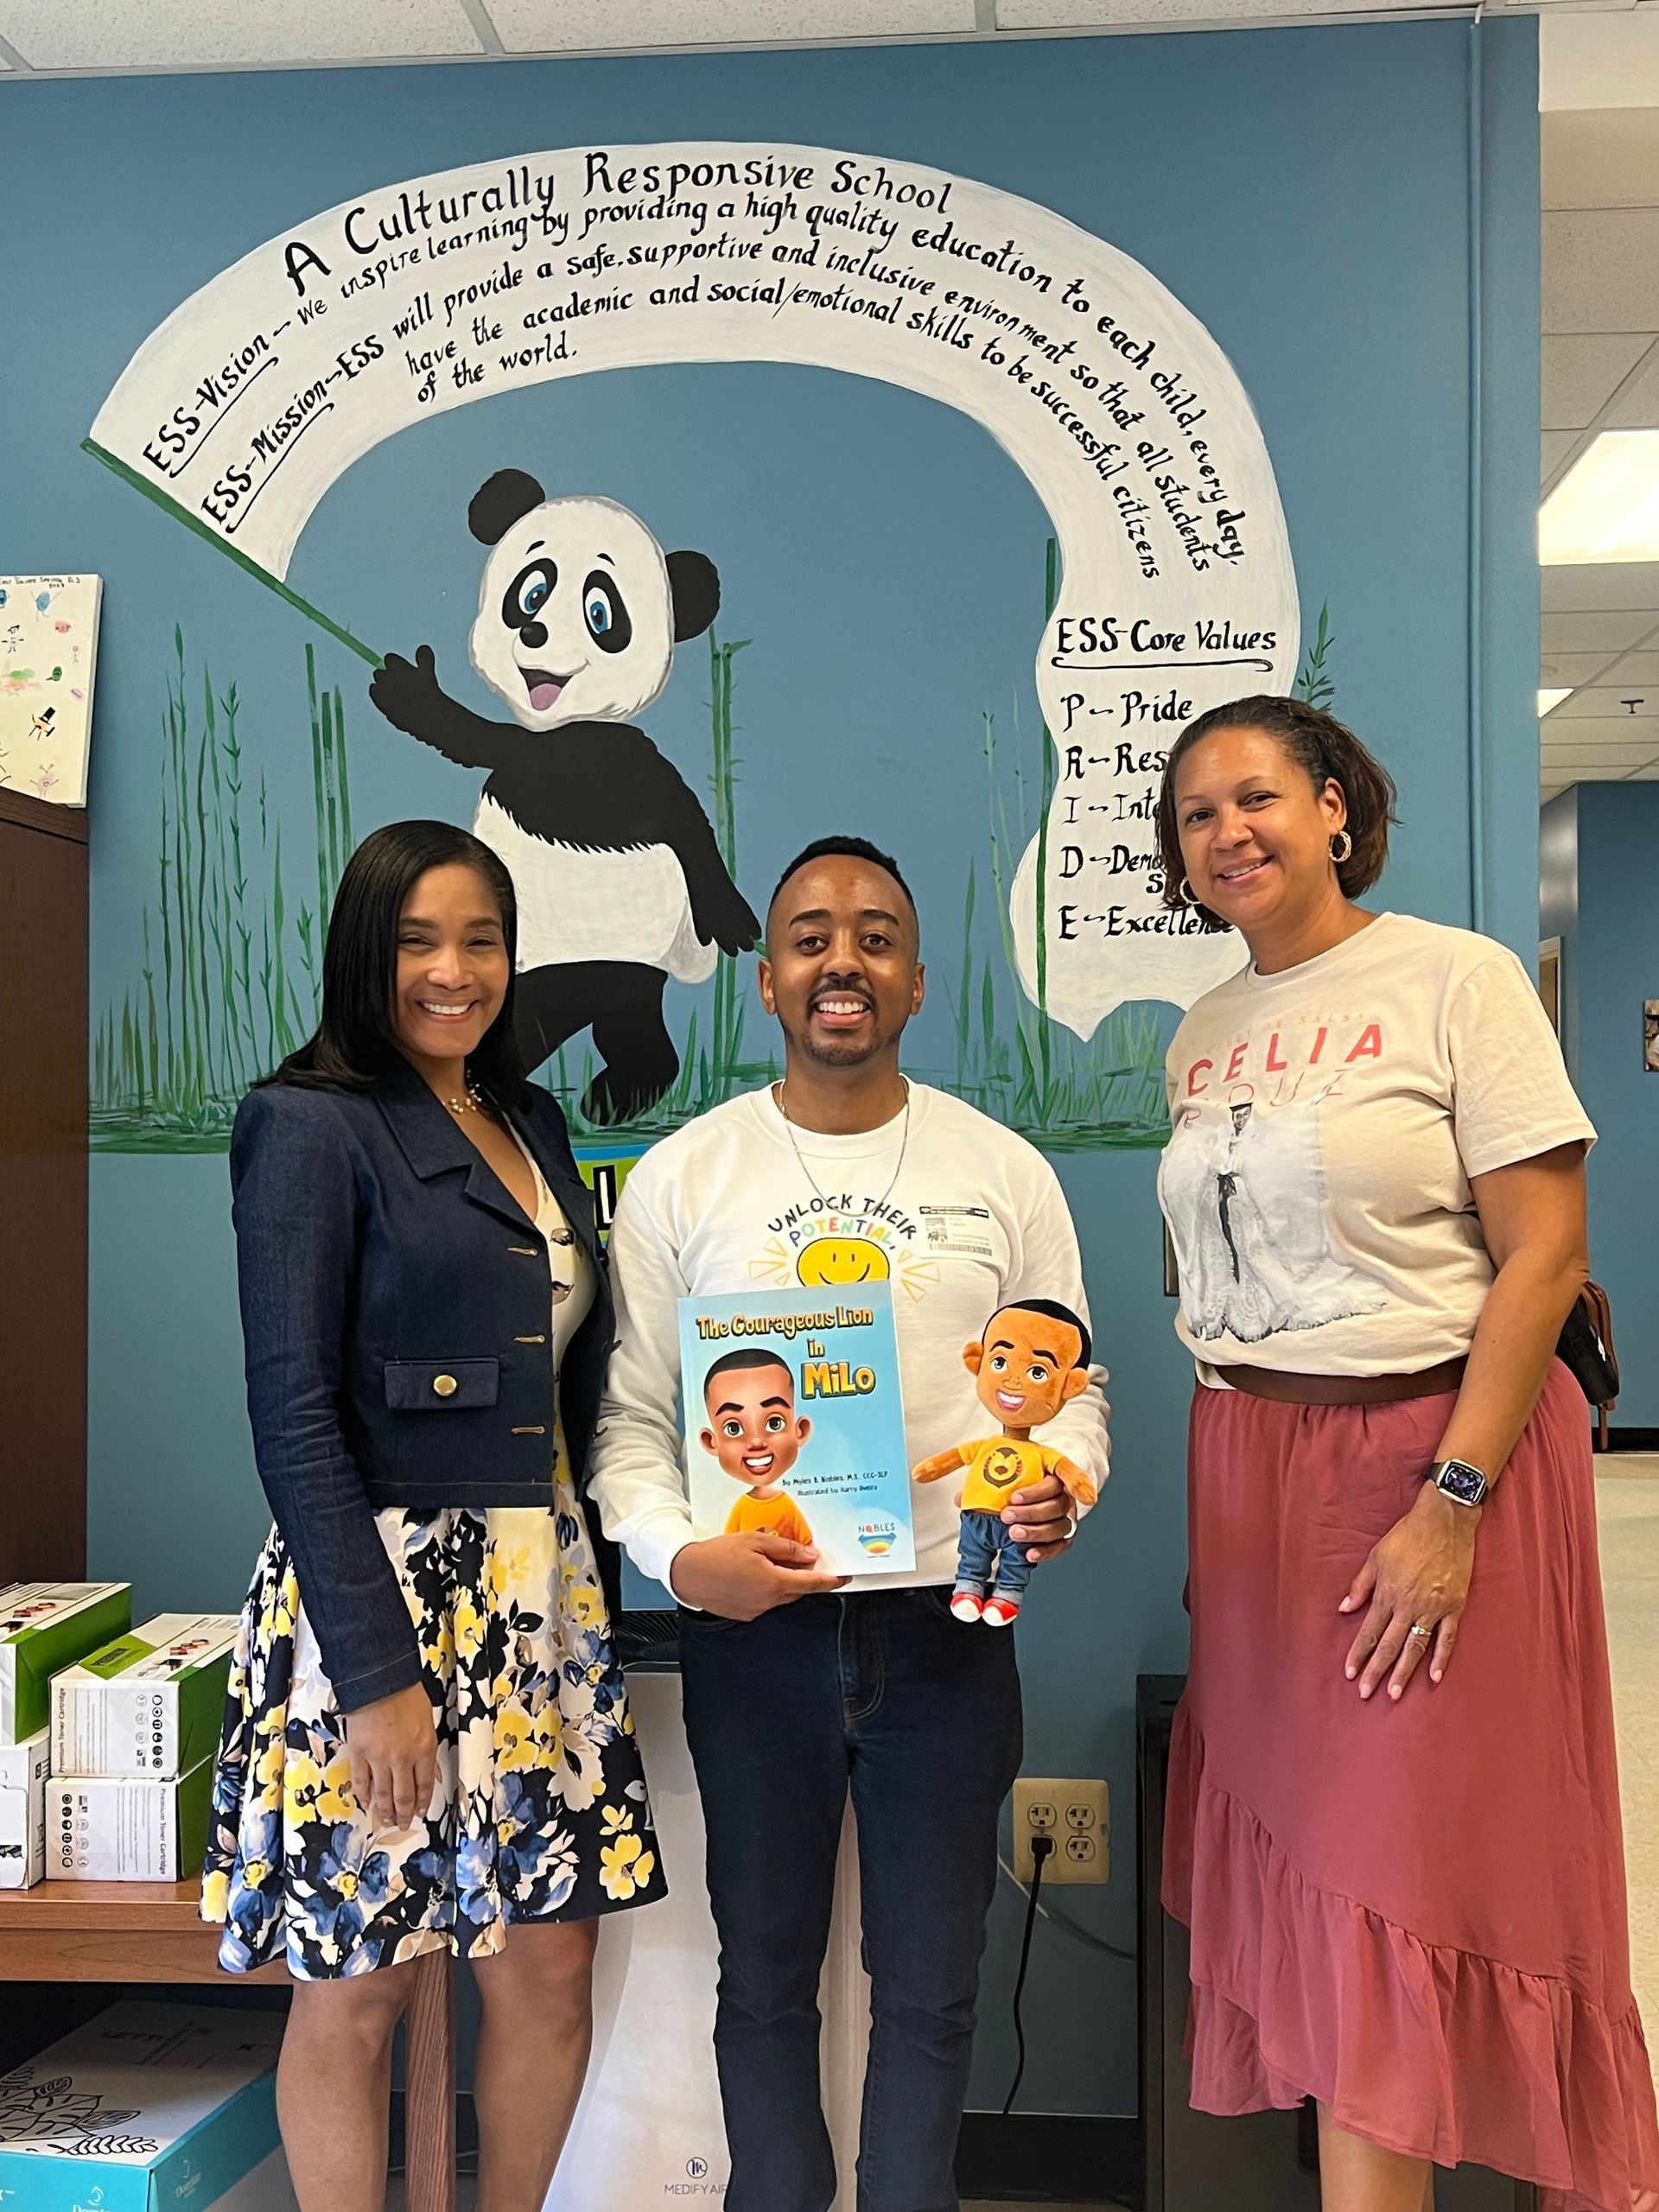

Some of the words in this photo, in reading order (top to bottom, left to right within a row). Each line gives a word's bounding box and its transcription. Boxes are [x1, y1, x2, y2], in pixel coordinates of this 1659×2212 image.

[284, 242, 332, 296] A
[345, 166, 554, 254] Culturally
[582, 152, 813, 202] Responsive
[830, 161, 952, 214] School
[537, 262, 554, 278] a
[626, 232, 762, 269] supportive
[772, 238, 820, 266] and
[826, 245, 936, 295] inclusive
[392, 292, 434, 340] will
[443, 261, 524, 327] provide
[143, 334, 271, 472] ESS-Vision
[297, 299, 327, 326] We
[340, 247, 422, 298] inspire
[427, 217, 529, 259] learning
[542, 210, 569, 246] by
[577, 194, 708, 240] providing
[717, 202, 735, 218] a
[745, 191, 798, 235] high
[805, 200, 899, 254] quality
[912, 221, 1052, 292] education
[1062, 279, 1090, 312] to
[1096, 315, 1155, 371] each
[1150, 372, 1206, 436] child,
[1190, 440, 1228, 503] every
[944, 291, 1077, 364] environment
[417, 370, 435, 403] of
[452, 357, 485, 389] the
[499, 330, 577, 372] world.
[1071, 365, 1098, 389] so
[405, 340, 457, 377] have
[472, 315, 503, 346] the
[523, 286, 633, 329] academic
[650, 274, 700, 304] and
[906, 306, 974, 348] skills
[981, 337, 1005, 364] to
[1007, 354, 1033, 384] be
[1031, 381, 1129, 480] successful
[1113, 486, 1160, 579] citizens
[1098, 382, 1146, 431] that
[1137, 442, 1173, 472] all
[1154, 475, 1211, 571] students
[1195, 620, 1276, 651] Values
[1120, 690, 1192, 728] Pride
[1188, 1024, 1381, 1096] CELIA
[768, 1193, 853, 1231] UNLOCK
[863, 1198, 916, 1239] THEIR
[696, 1316, 729, 1339] The
[731, 1311, 836, 1339] Courageous
[836, 1306, 874, 1327] Lion
[807, 1337, 825, 1357] in
[664, 2184, 709, 2195] MEDIFY
